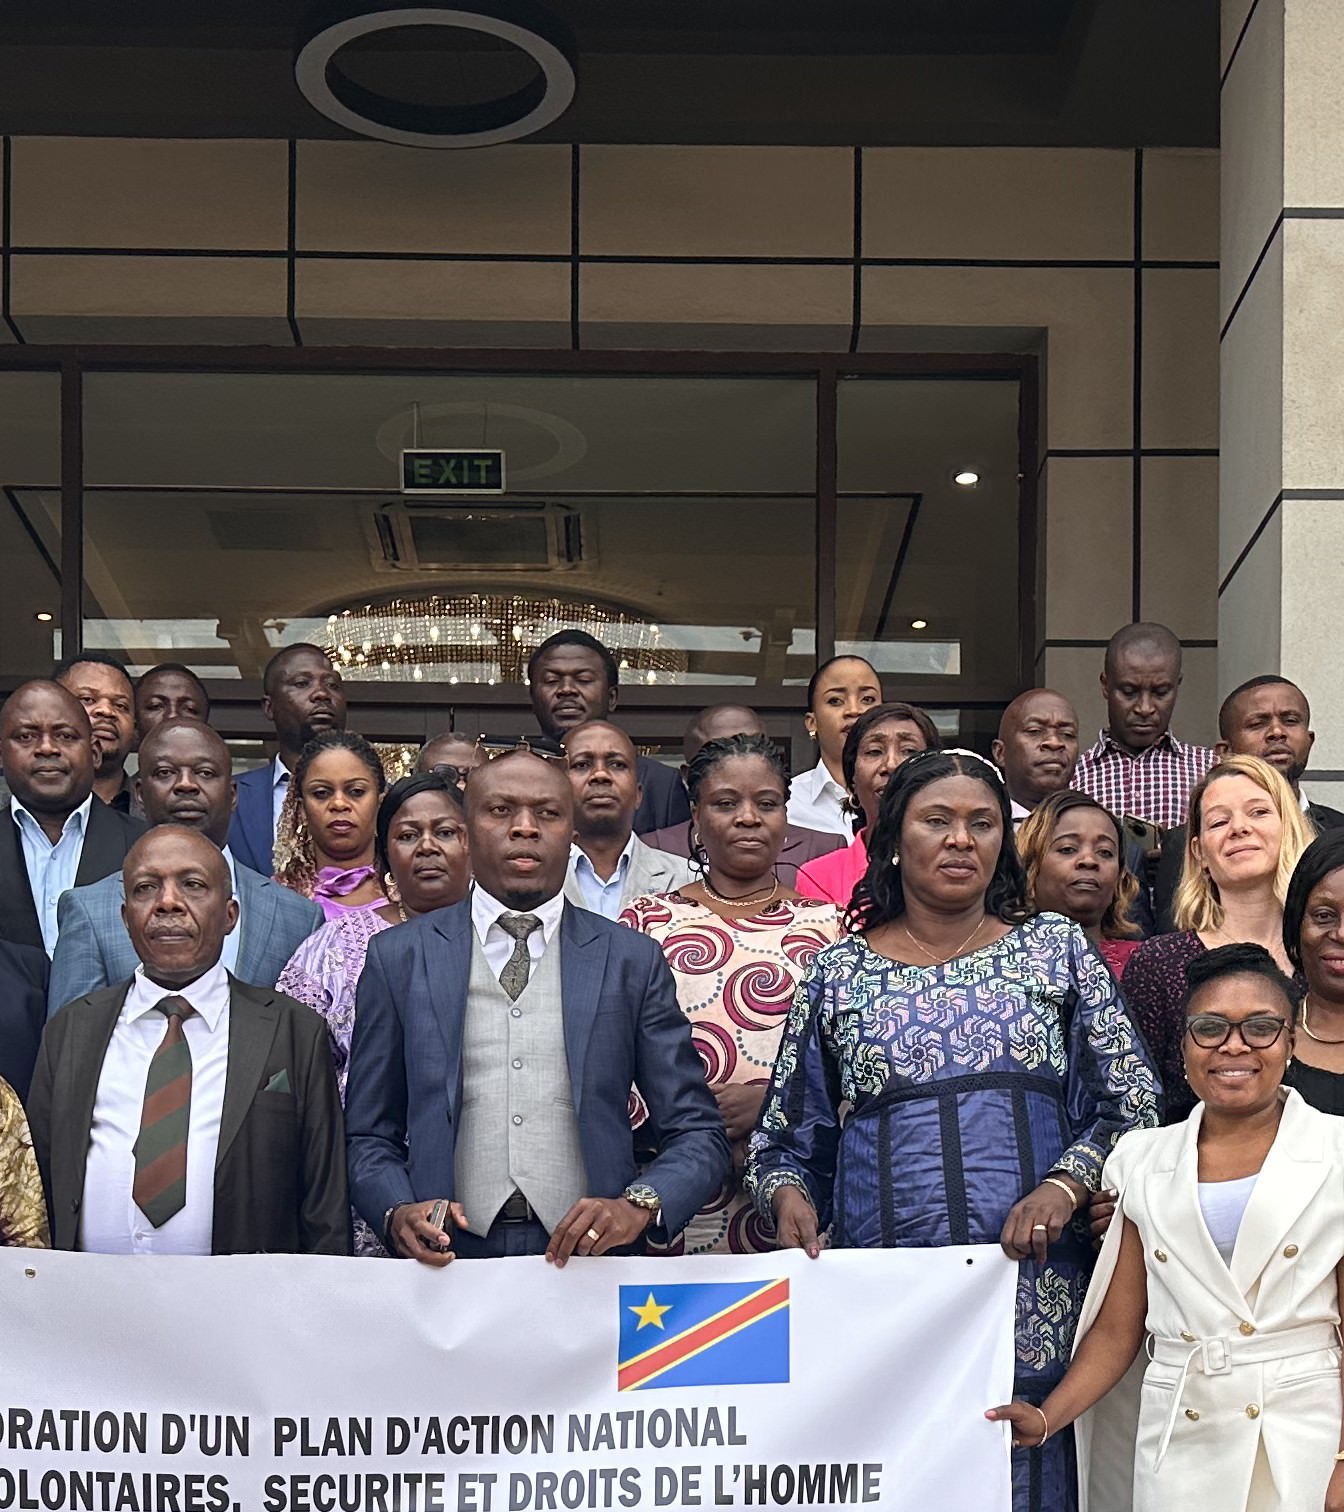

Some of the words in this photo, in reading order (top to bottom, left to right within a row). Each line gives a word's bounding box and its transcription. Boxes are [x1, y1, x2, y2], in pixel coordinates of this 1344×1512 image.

[413, 458, 493, 484] EXIT
[161, 1413, 250, 1457] D'UN
[273, 1415, 373, 1458] PLAN
[385, 1413, 554, 1457] D'ACTION
[567, 1405, 748, 1453] NATIONAL
[507, 1467, 642, 1512] DROITS
[652, 1465, 702, 1508] DE
[714, 1463, 884, 1506] L’HOMME
